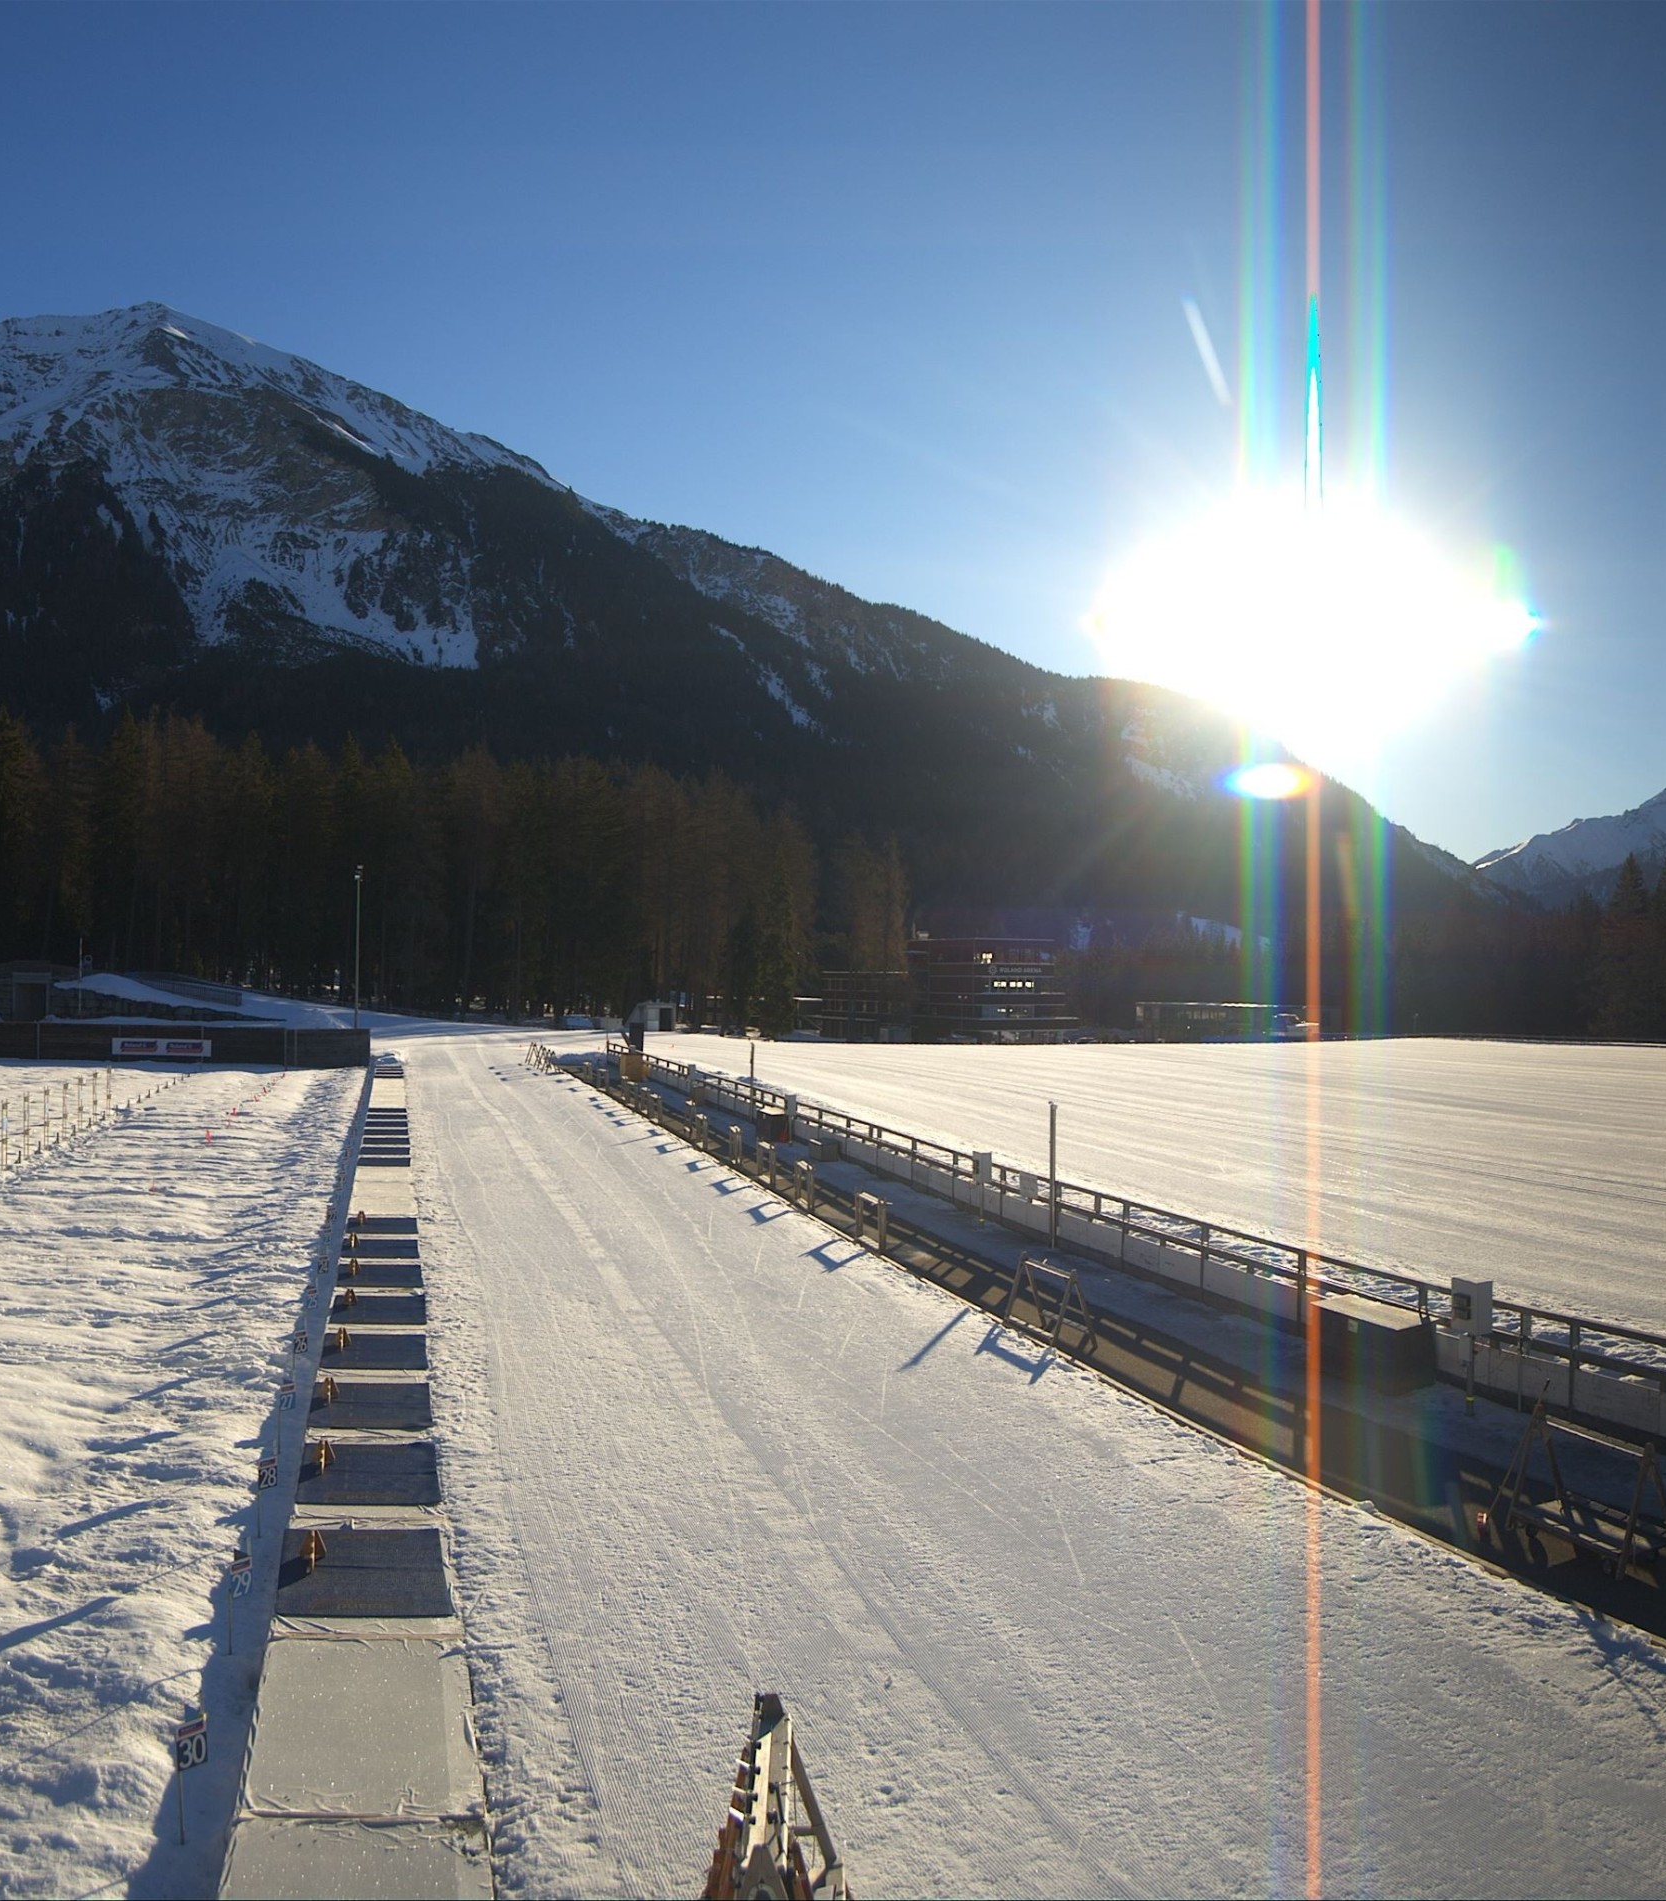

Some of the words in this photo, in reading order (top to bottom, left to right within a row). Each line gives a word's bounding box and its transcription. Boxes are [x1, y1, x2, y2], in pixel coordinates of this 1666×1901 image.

[294, 1339, 308, 1353] 26
[280, 1393, 295, 1411] 27
[259, 1466, 278, 1490] 28
[231, 1570, 253, 1599] 29
[178, 1733, 208, 1770] 30
